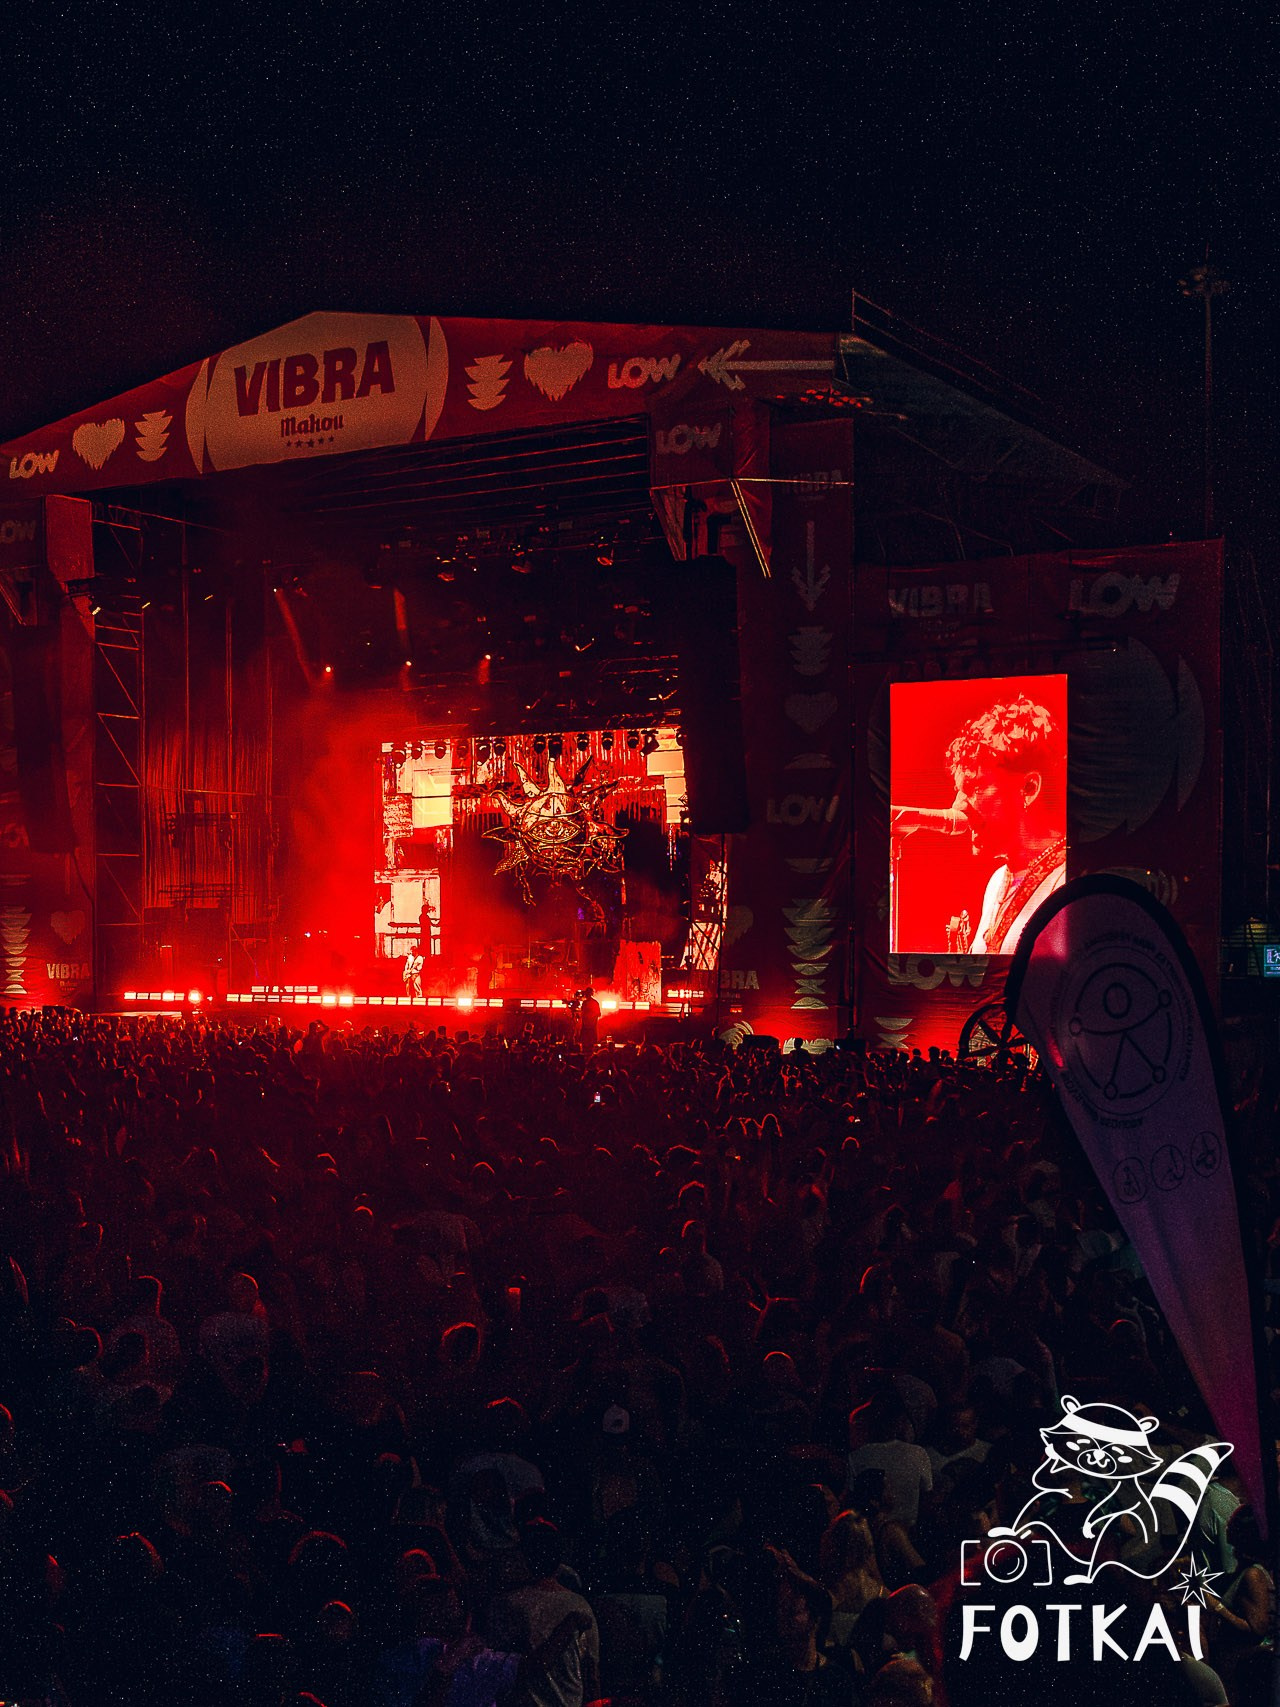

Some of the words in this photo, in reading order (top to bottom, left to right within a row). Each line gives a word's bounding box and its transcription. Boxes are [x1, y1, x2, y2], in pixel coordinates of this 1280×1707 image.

[234, 341, 395, 417] VIBRA
[607, 353, 682, 389] LOW
[281, 414, 344, 438] Mahou
[656, 422, 722, 455] LOW
[9, 449, 60, 480] LOW
[888, 582, 994, 618] VIBRA
[1068, 570, 1181, 619] LOW
[766, 792, 840, 826] LOW
[46, 962, 90, 979] VIBRA
[719, 969, 760, 990] BRA
[887, 954, 990, 990] LOW
